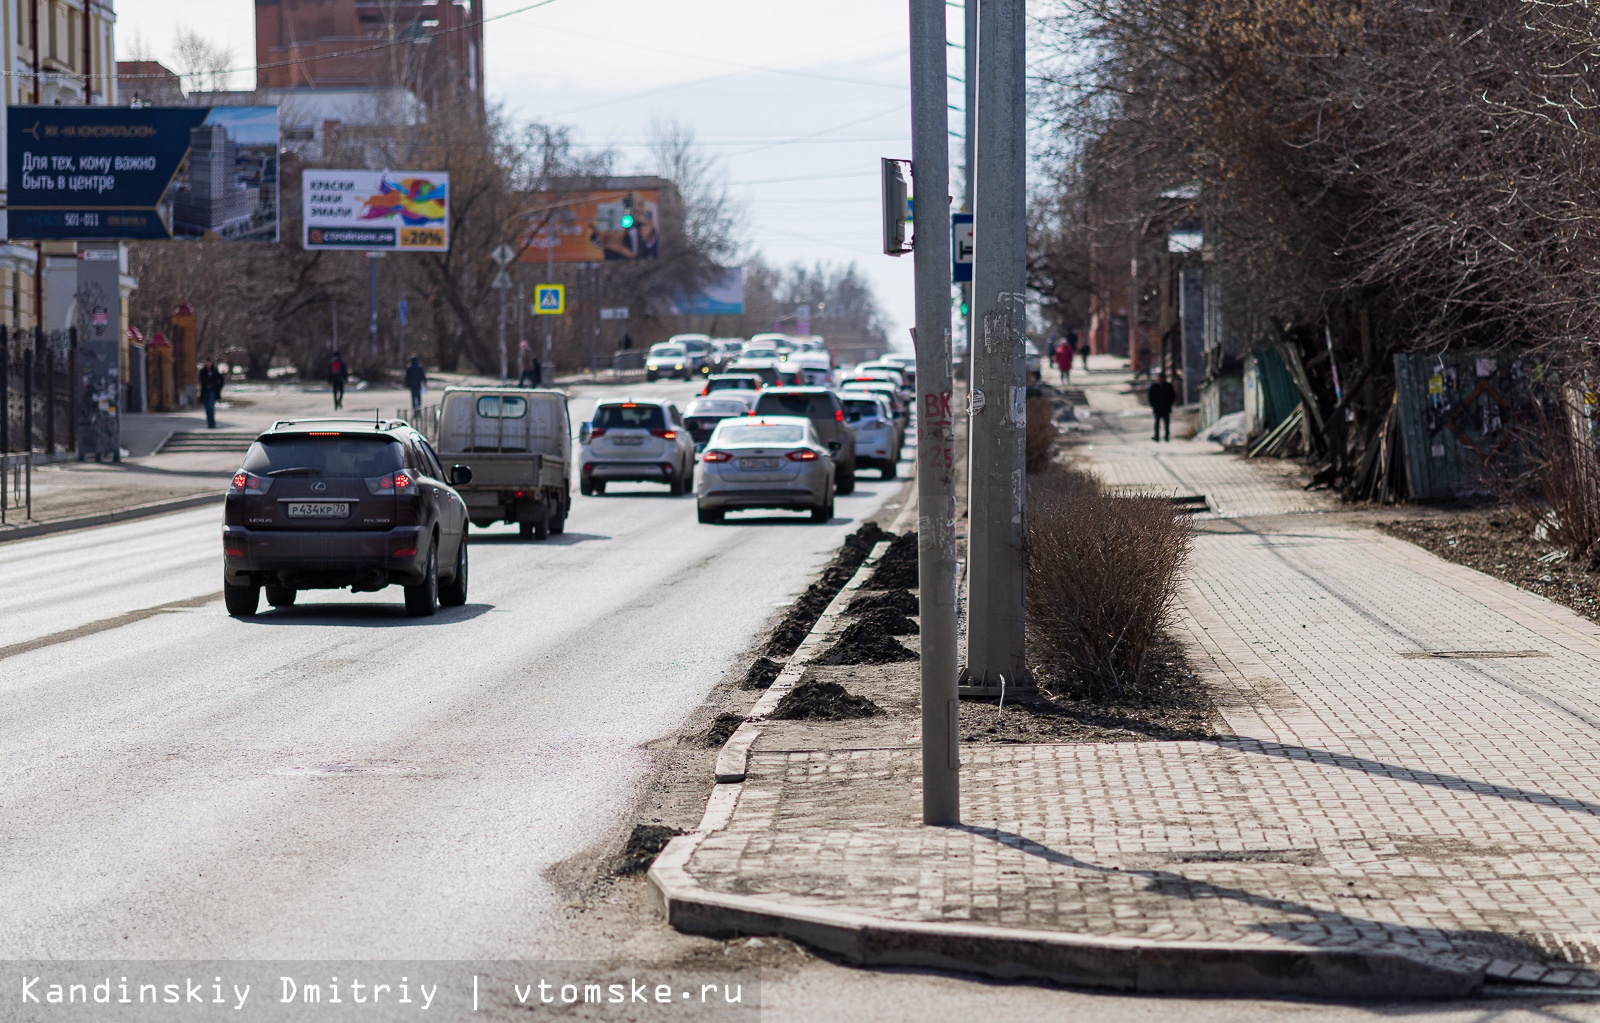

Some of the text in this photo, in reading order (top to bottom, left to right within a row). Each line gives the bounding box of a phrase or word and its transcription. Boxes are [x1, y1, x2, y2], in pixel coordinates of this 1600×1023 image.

[22, 151, 156, 174] Для тех, кому важно
[22, 172, 114, 194] быть в центре
[310, 181, 354, 191] КРАСКИ
[310, 195, 342, 204] ЛАКИ
[311, 208, 352, 217] ЭМАЛИ
[64, 212, 99, 227] 501-011
[335, 504, 346, 512] 70
